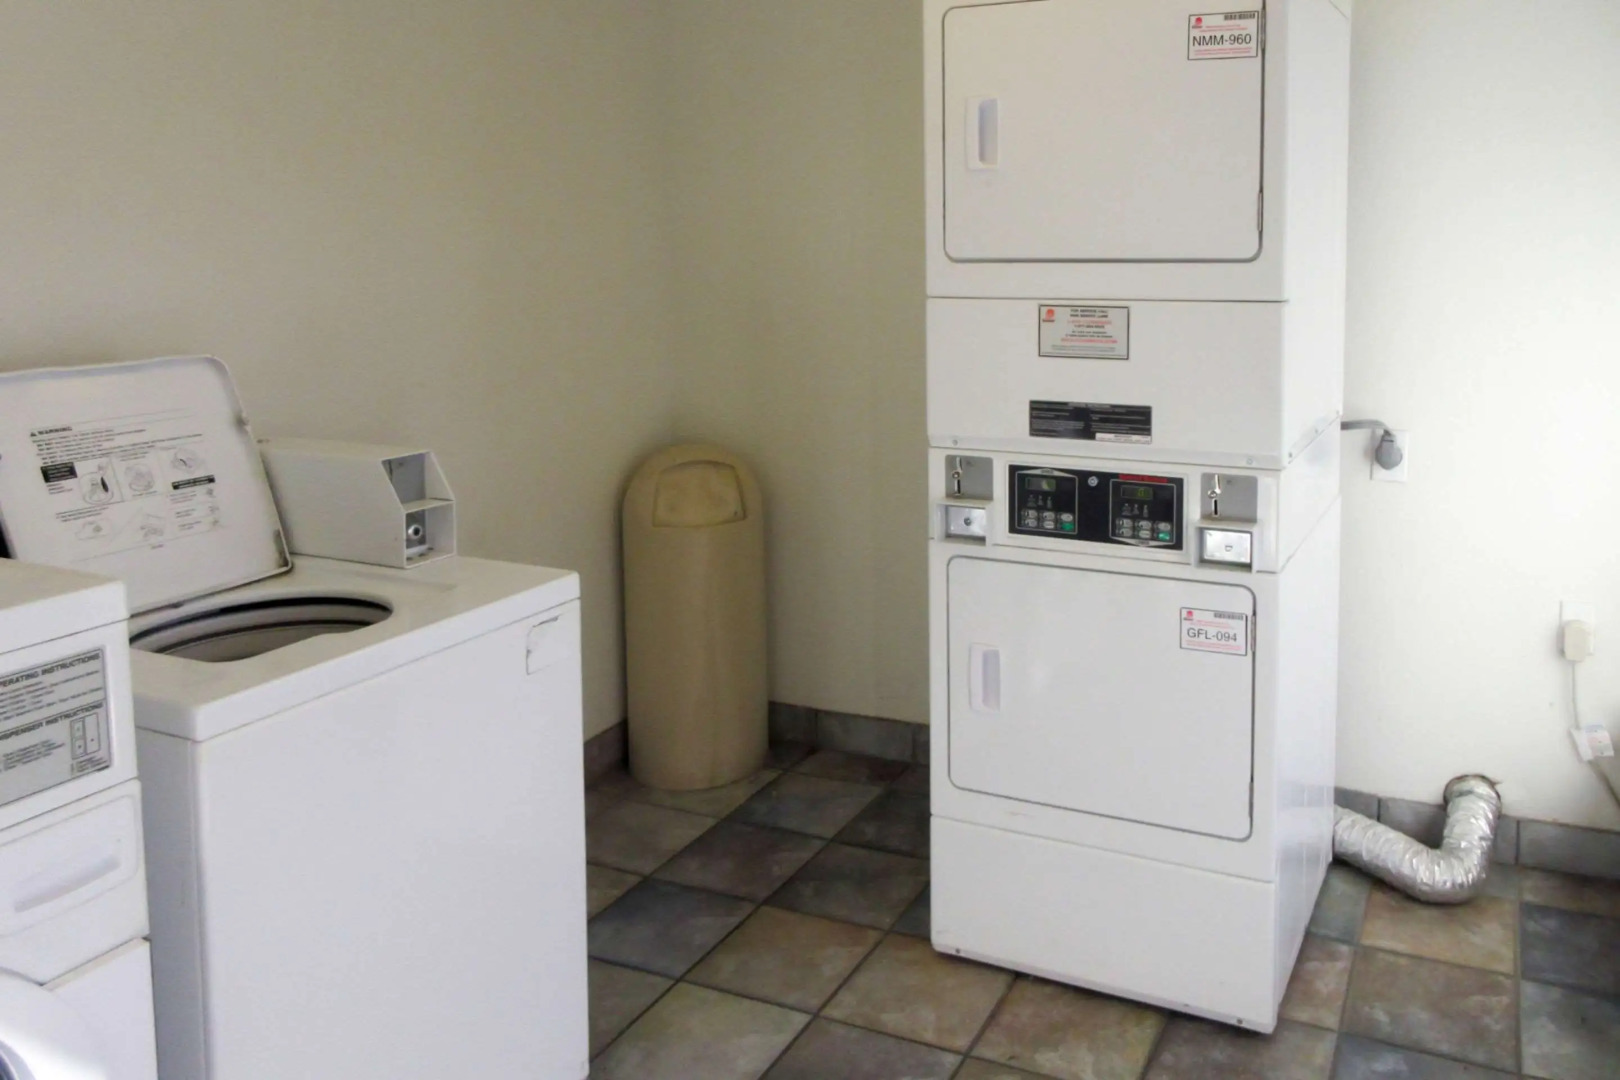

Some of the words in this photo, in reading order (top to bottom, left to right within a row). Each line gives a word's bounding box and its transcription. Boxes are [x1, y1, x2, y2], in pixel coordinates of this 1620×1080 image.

[1192, 33, 1252, 47] NMM-960
[1187, 627, 1238, 642] GFL-094
[41, 652, 101, 675] INSTRUCTIONS
[45, 702, 103, 726] INSTRUCTIONS
